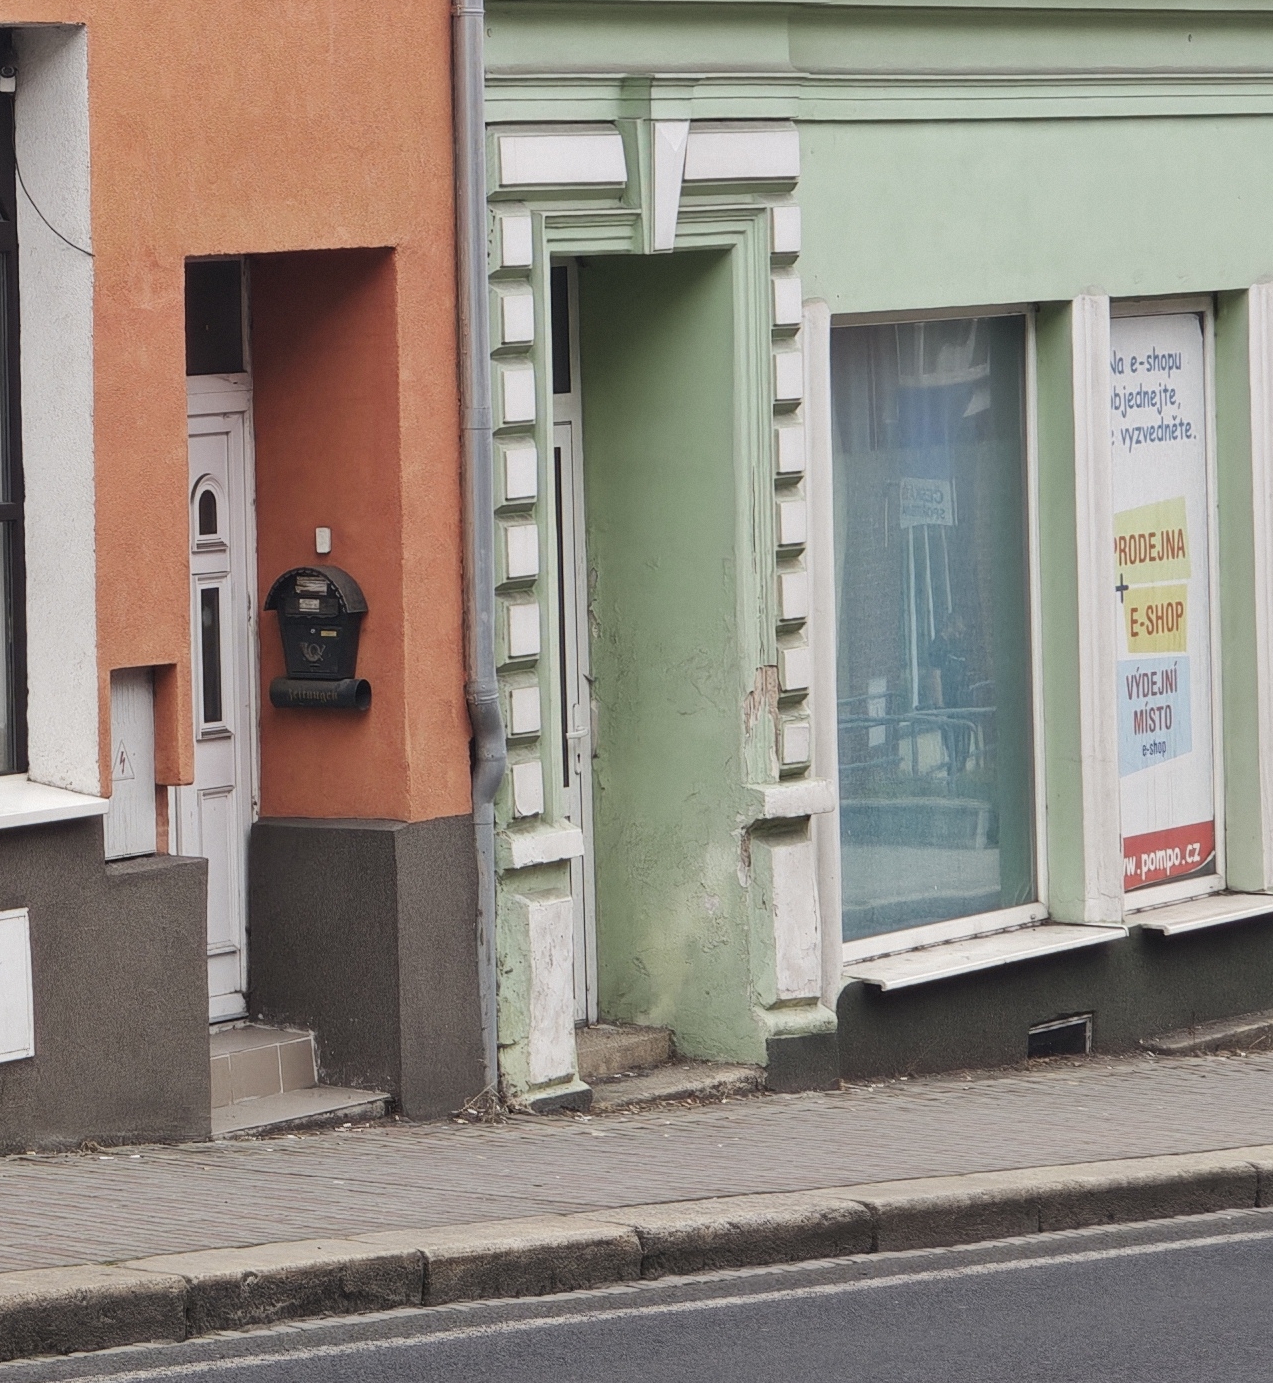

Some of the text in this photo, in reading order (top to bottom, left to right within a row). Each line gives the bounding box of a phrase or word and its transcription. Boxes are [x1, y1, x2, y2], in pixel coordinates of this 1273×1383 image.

[1130, 345, 1182, 379] e-shopu
[1110, 382, 1181, 419] bjednejte,
[1120, 415, 1197, 454] vyzvedněte.
[1130, 601, 1184, 638] E-SHOP
[1125, 660, 1178, 700] VÝDEJNÍ
[1133, 700, 1173, 736] MÍSTO
[1142, 739, 1167, 759] e-shop
